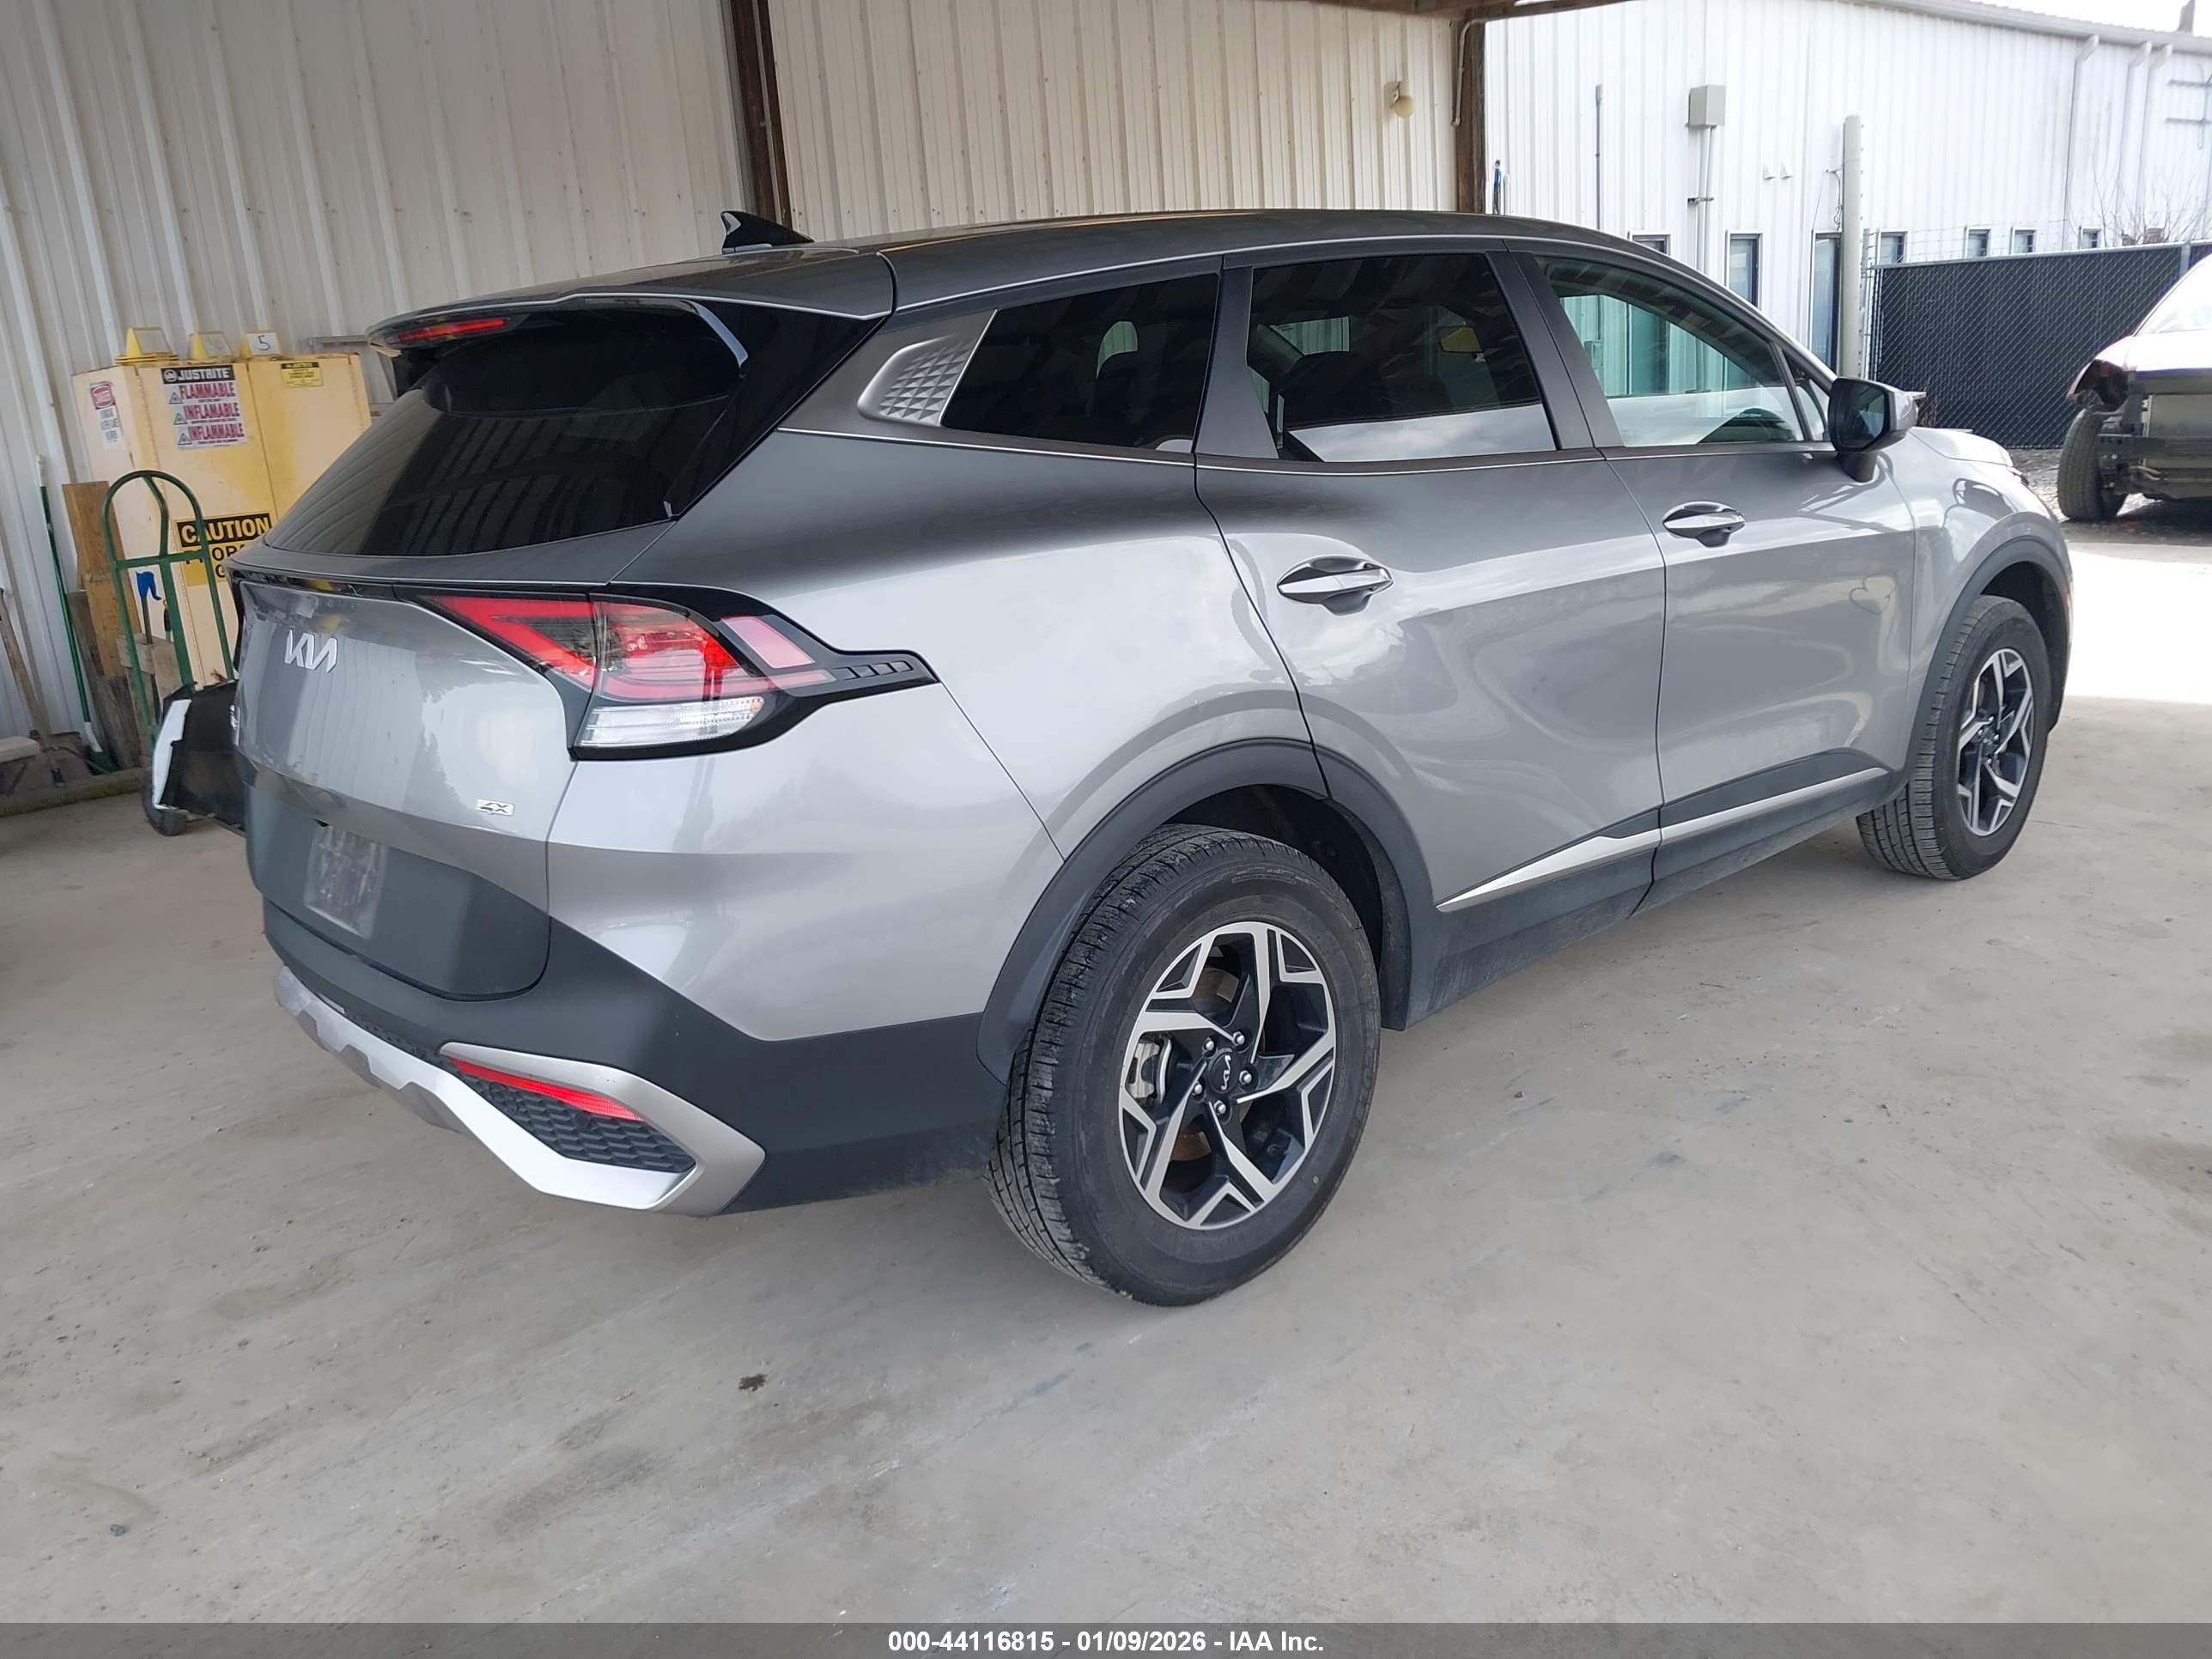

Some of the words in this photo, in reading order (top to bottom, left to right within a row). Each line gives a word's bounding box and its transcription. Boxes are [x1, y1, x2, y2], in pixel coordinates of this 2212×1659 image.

[258, 334, 271, 351] 5
[178, 368, 230, 380] JUSTRITE
[179, 381, 236, 399] FLAMMABLE
